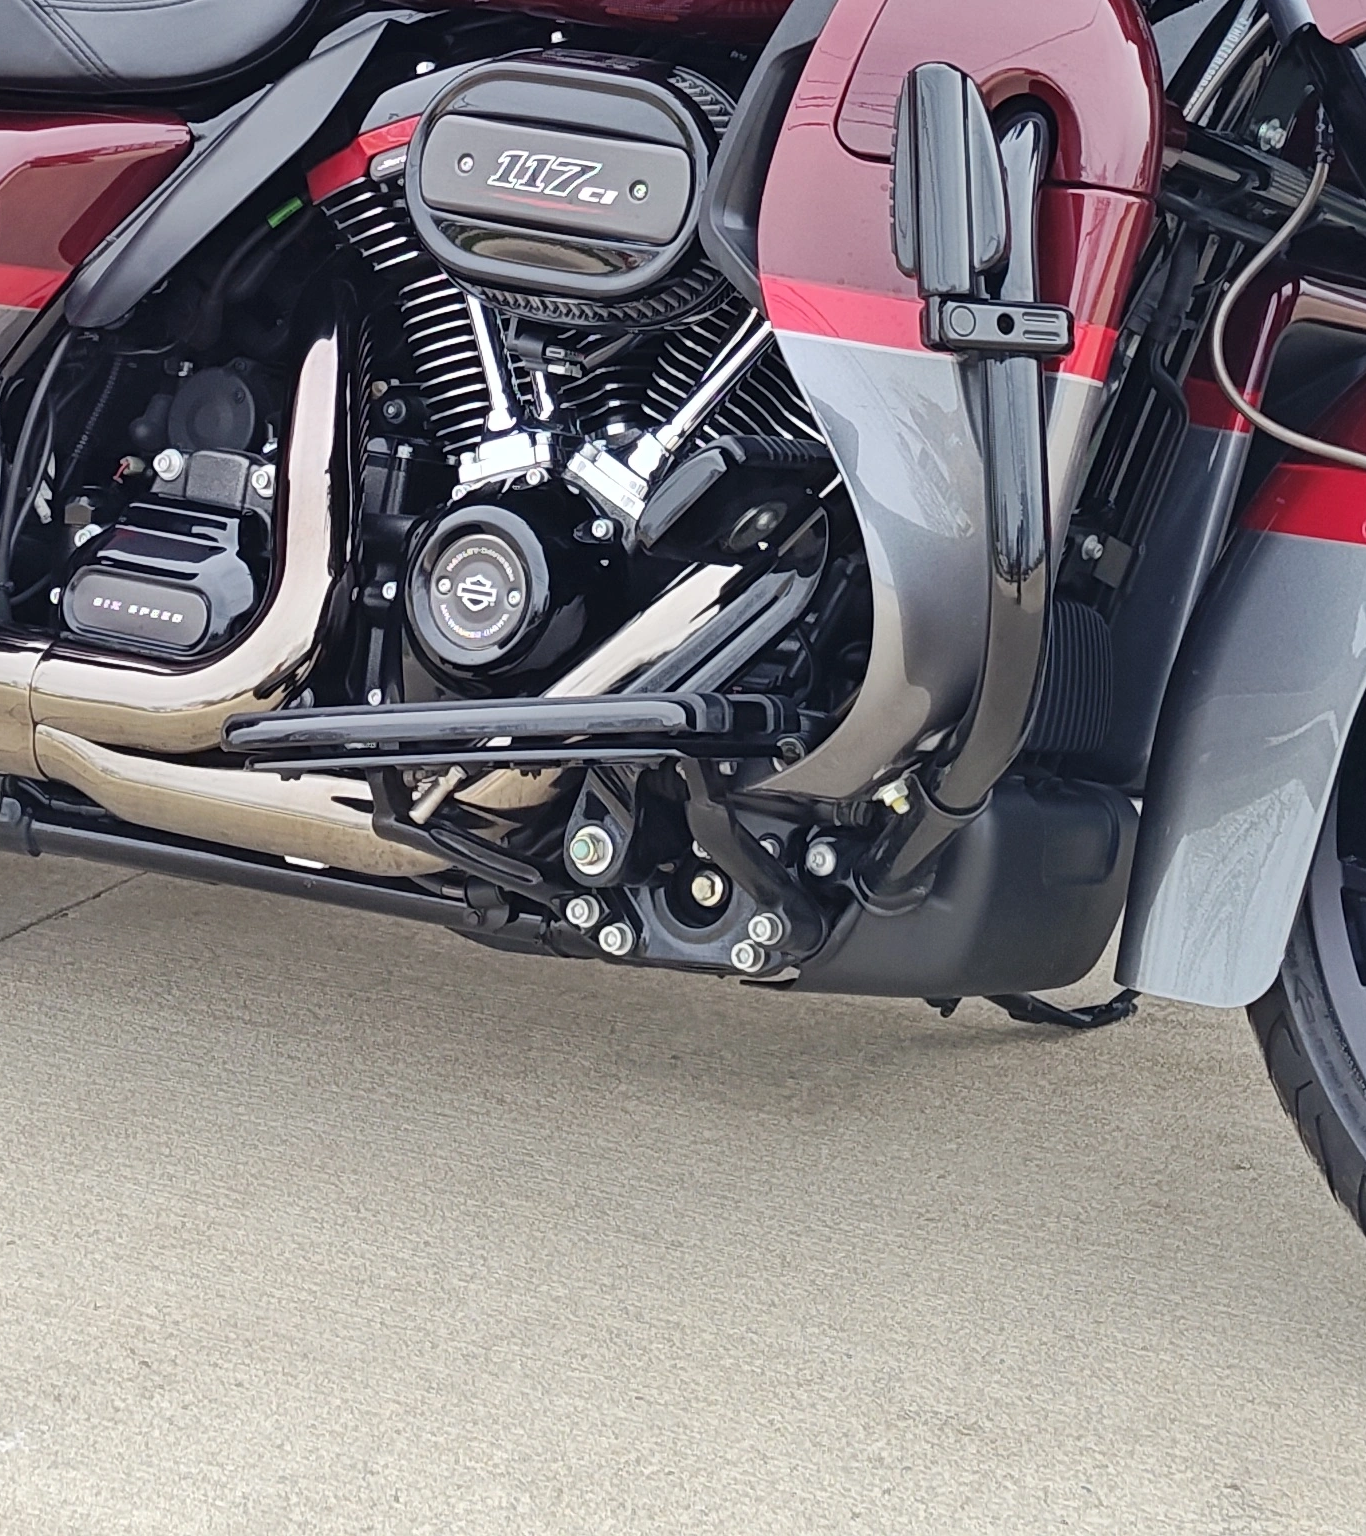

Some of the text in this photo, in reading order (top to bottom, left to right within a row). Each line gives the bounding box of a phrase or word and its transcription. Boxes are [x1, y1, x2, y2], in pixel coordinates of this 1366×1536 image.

[487, 150, 603, 197] 117
[92, 597, 183, 624] SIX SPEED
